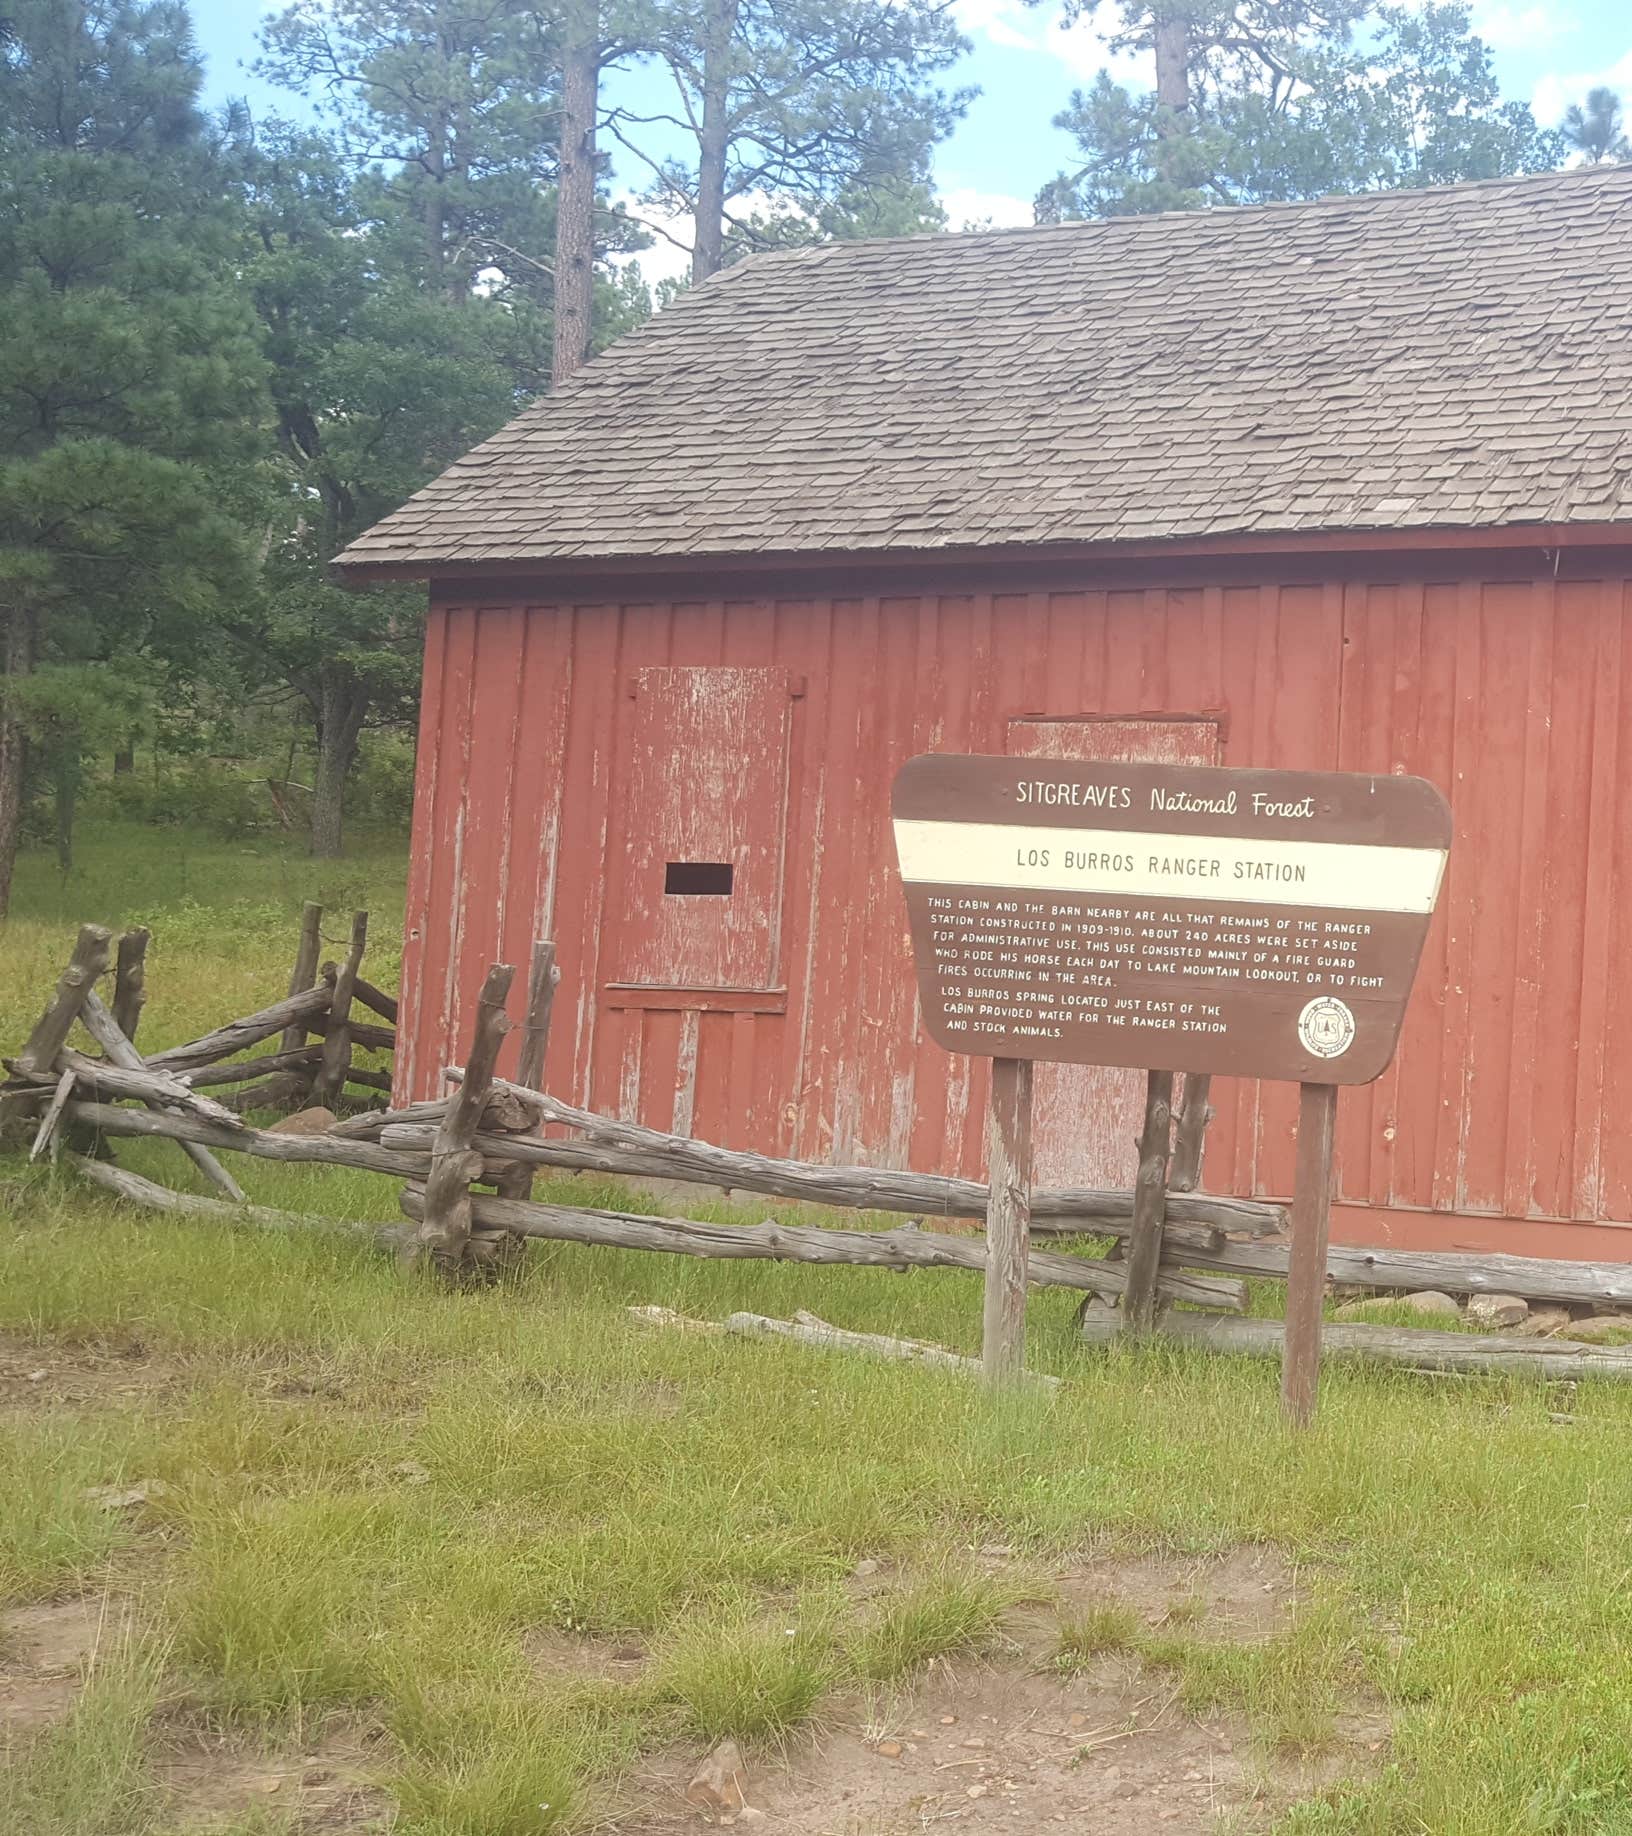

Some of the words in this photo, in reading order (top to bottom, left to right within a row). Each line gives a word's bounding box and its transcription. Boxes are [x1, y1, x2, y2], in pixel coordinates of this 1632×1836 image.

[1015, 780, 1132, 809] SITGREAVES
[1149, 787, 1238, 815] National
[1250, 792, 1316, 818] Forest
[1017, 848, 1050, 868] LOS
[1064, 850, 1134, 873] BURROS
[1148, 856, 1221, 878] RANGER
[1233, 861, 1306, 883] STATION
[927, 897, 952, 909] THIS
[958, 899, 990, 910] CABIN
[995, 901, 1018, 913] AND
[1024, 903, 1045, 914] THE
[1051, 905, 1081, 916] BARN
[1086, 907, 1130, 920] NEARBY
[1134, 910, 1156, 922] ARE
[1161, 912, 1183, 923] ALL
[1186, 913, 1215, 925] THAT
[1219, 915, 1270, 929] REMAINS
[1276, 919, 1292, 930] OF
[1297, 920, 1319, 932] THE
[1324, 922, 1371, 935] RANGER
[930, 913, 974, 926] STATION
[979, 917, 1056, 932] CONSTRUCTED
[1061, 922, 1072, 933] IN
[1077, 923, 1135, 937] 1909-1910.
[1140, 928, 1180, 940] ABOUT
[1185, 929, 1209, 942] 240
[1213, 933, 1251, 945] ACRES
[1256, 935, 1289, 948] WERE
[1295, 937, 1319, 949] SET
[1323, 939, 1358, 952] ASIDE
[933, 930, 955, 942] FOR
[960, 932, 1051, 949] ADMINISTRATIVE
[1056, 939, 1081, 951] USE.
[1085, 940, 1110, 953] THIS
[1115, 943, 1136, 954] USE
[1141, 944, 1202, 958] CONSISTED
[1207, 949, 1248, 961] MAINLY
[1253, 952, 1268, 963] OF
[1271, 954, 1280, 964] A
[1285, 954, 1311, 966] FIRE
[1316, 956, 1356, 969] GUARD
[935, 947, 959, 959] WHO
[963, 949, 994, 961] RODE
[999, 951, 1018, 963] HIS
[1023, 953, 1061, 966] HORSE
[1066, 956, 1094, 968] EACH
[1099, 958, 1120, 969] DAY
[1127, 959, 1142, 971] TO
[1147, 962, 1177, 974] LAKE
[1182, 965, 1240, 977] MOUNTAIN
[1306, 972, 1322, 984] OR
[1329, 973, 1345, 986] TO
[1349, 975, 1384, 988] FIGHT
[937, 963, 968, 977] FIRES
[973, 966, 1032, 981] OCCURRING
[1037, 970, 1050, 983] IN
[1055, 972, 1076, 985] THE
[1081, 974, 1118, 988] AREA.
[940, 986, 962, 997] LOS
[967, 987, 1010, 1001] BURROS
[1015, 991, 1055, 1004] SPRING
[1060, 994, 1109, 1008] LOCATED
[1113, 998, 1142, 1010] JUST
[1145, 1000, 1175, 1013] EAST
[1179, 1003, 1194, 1014] OF
[1200, 1004, 1222, 1017] THE
[943, 1002, 974, 1015] CABIN
[979, 1004, 1033, 1019] PROVIDED
[1037, 1009, 1073, 1022] WATER
[1078, 1012, 1099, 1024] FOR
[1105, 1014, 1127, 1027] THE
[1131, 1016, 1176, 1030] RANGER
[1181, 1020, 1227, 1033] STATION
[945, 1019, 968, 1031] AND
[972, 1021, 1006, 1034] STOCK
[1011, 1025, 1064, 1038] ANIMALS.
